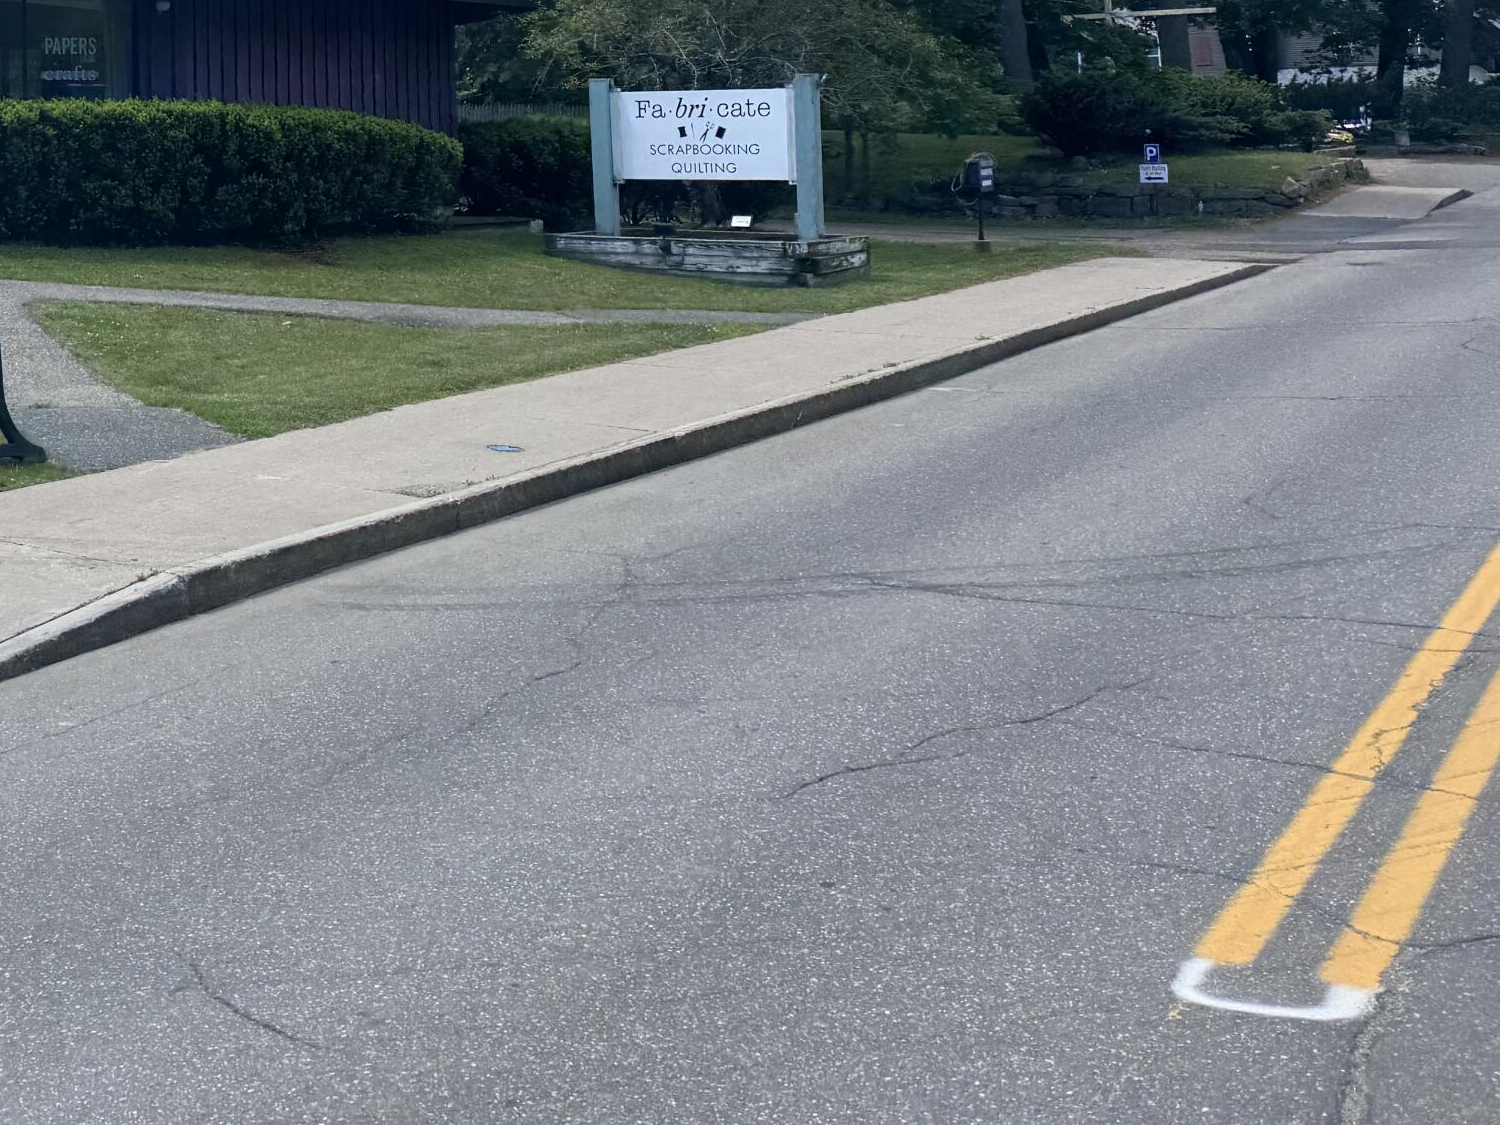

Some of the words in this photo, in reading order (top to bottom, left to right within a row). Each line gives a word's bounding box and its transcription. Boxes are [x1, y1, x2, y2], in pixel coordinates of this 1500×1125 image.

[44, 37, 97, 55] PAPERS
[650, 143, 760, 156] SCRAPBOOKING
[1146, 146, 1157, 161] P
[671, 161, 737, 175] QUILTING
